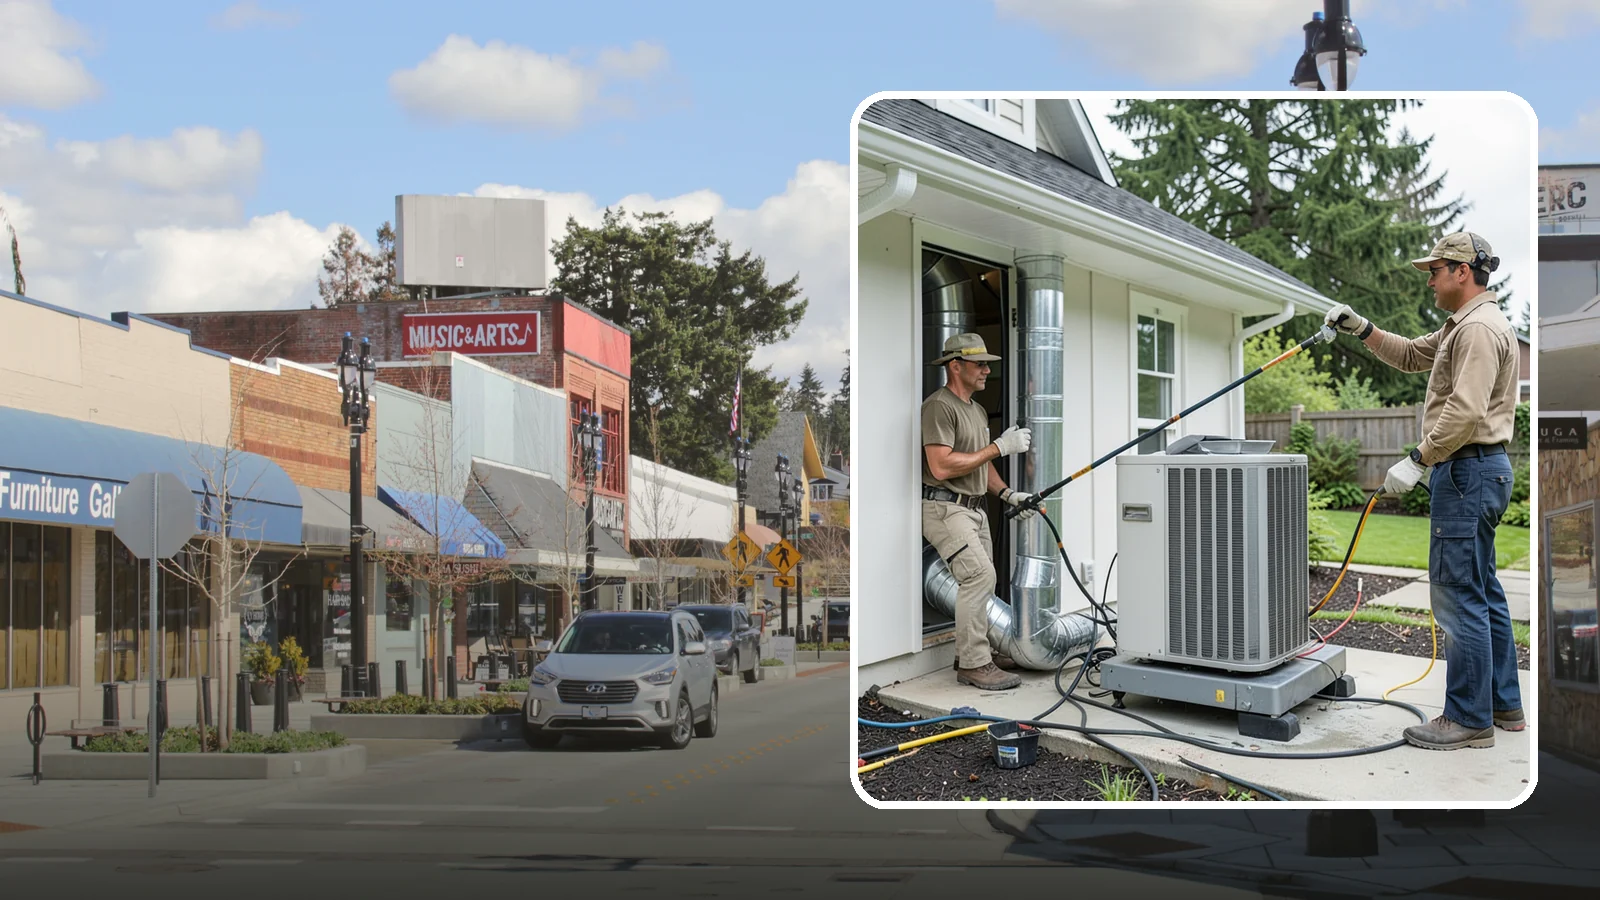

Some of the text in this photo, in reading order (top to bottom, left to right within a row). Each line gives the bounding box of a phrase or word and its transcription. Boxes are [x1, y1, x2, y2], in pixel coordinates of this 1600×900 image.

[409, 323, 520, 349] MUSIC&ARTS
[1540, 427, 1577, 436] UGA
[0, 471, 79, 515] Furniture
